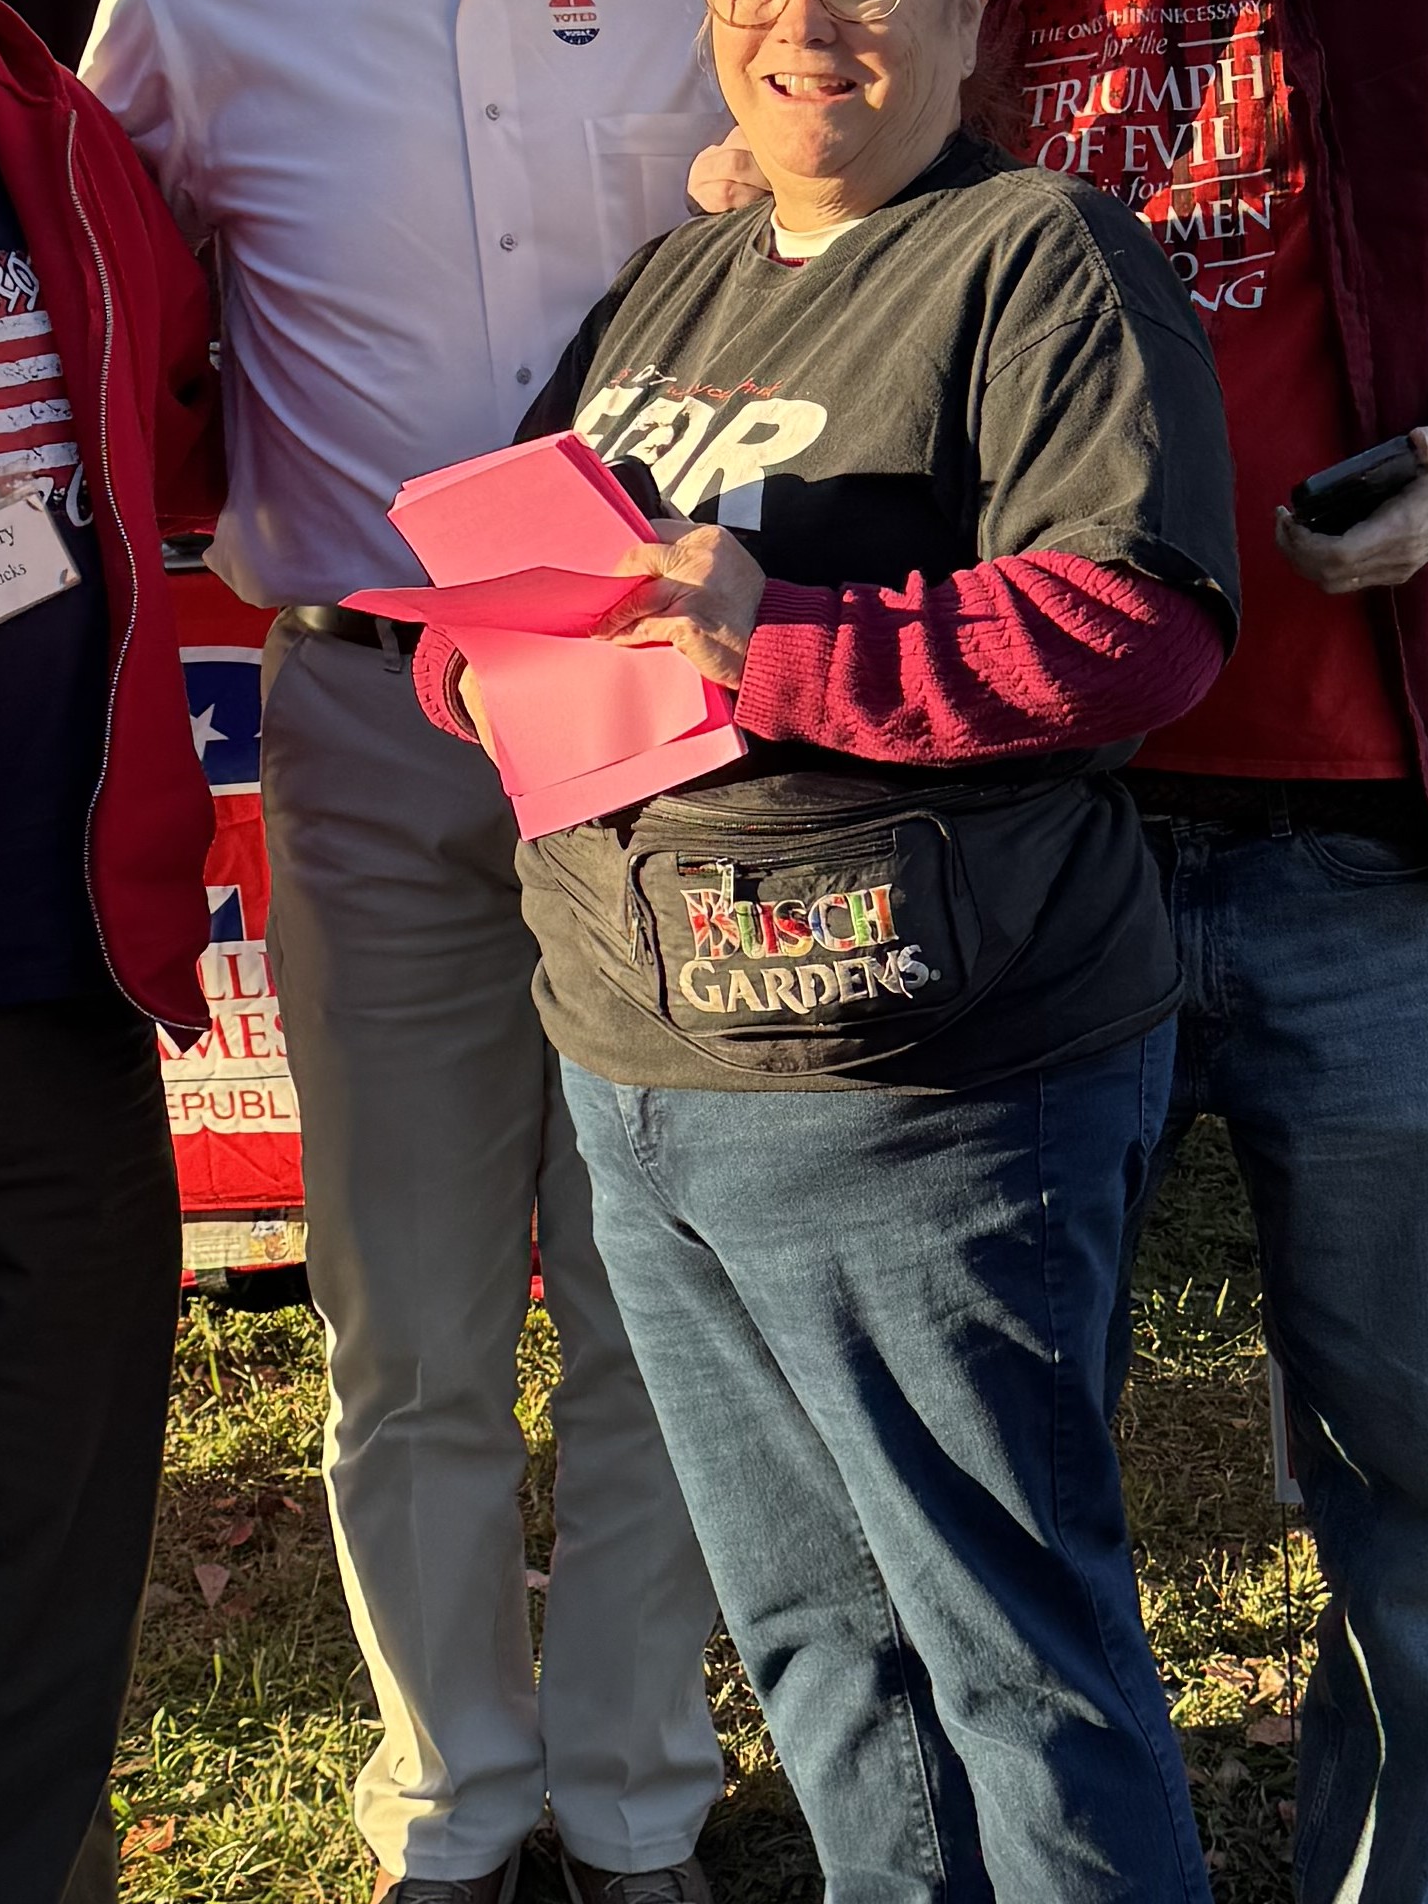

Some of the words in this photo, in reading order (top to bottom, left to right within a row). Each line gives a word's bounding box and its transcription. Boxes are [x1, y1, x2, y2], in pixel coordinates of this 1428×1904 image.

[1098, 33, 1134, 68] for
[1022, 54, 1265, 128] TRIUMPH
[1036, 127, 1106, 174] OF
[1122, 116, 1243, 173] EVIL
[680, 883, 900, 961] BUSCH
[679, 944, 930, 1015] GARDENS
